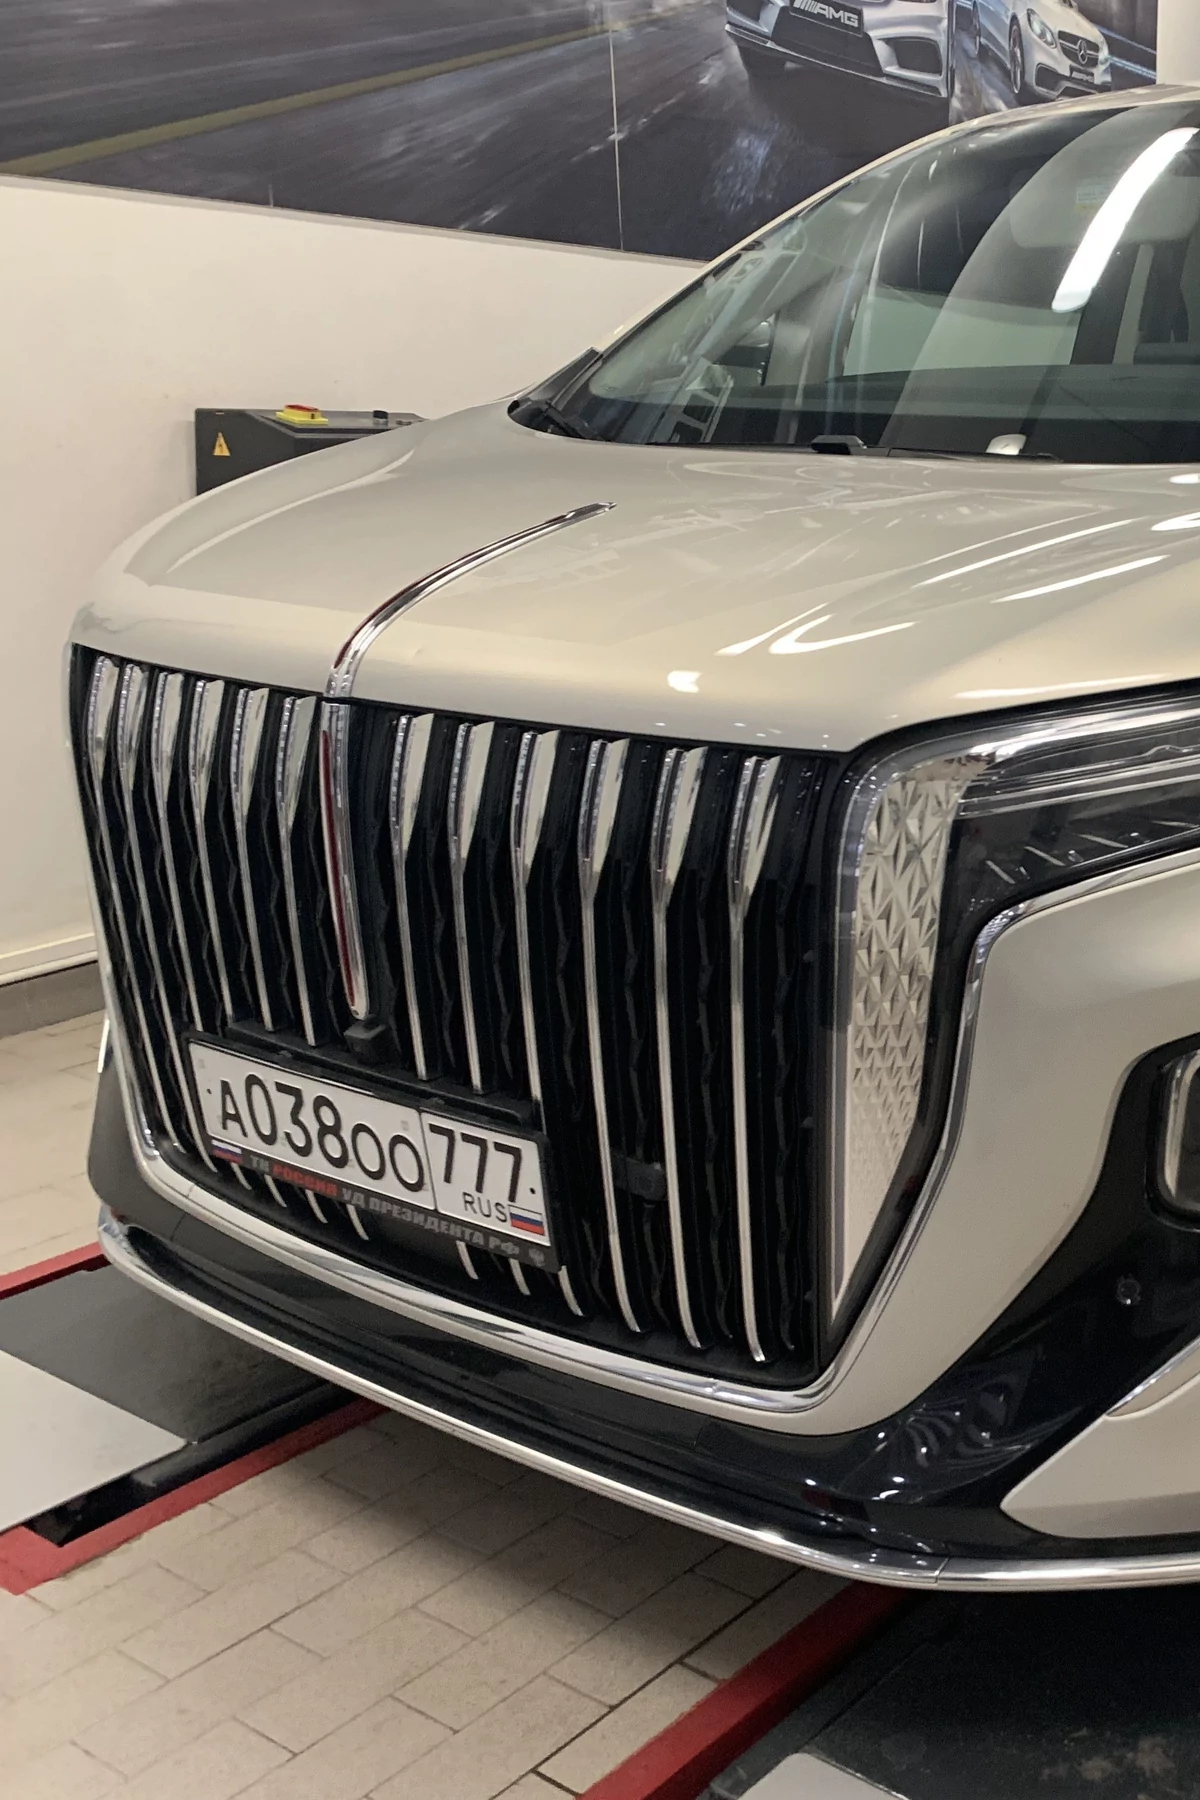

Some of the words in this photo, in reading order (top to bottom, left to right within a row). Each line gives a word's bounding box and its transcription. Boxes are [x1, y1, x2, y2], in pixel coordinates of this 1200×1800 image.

[812, 2, 859, 28] AMG
[220, 1073, 425, 1193] A038OO
[429, 1123, 523, 1203] 777
[272, 1163, 338, 1197] РОССИЯ
[342, 1187, 366, 1209] УД
[369, 1196, 485, 1246] ПРЕЗИДЕНТА
[489, 1235, 520, 1256] РФ
[462, 1191, 508, 1223] RUS
